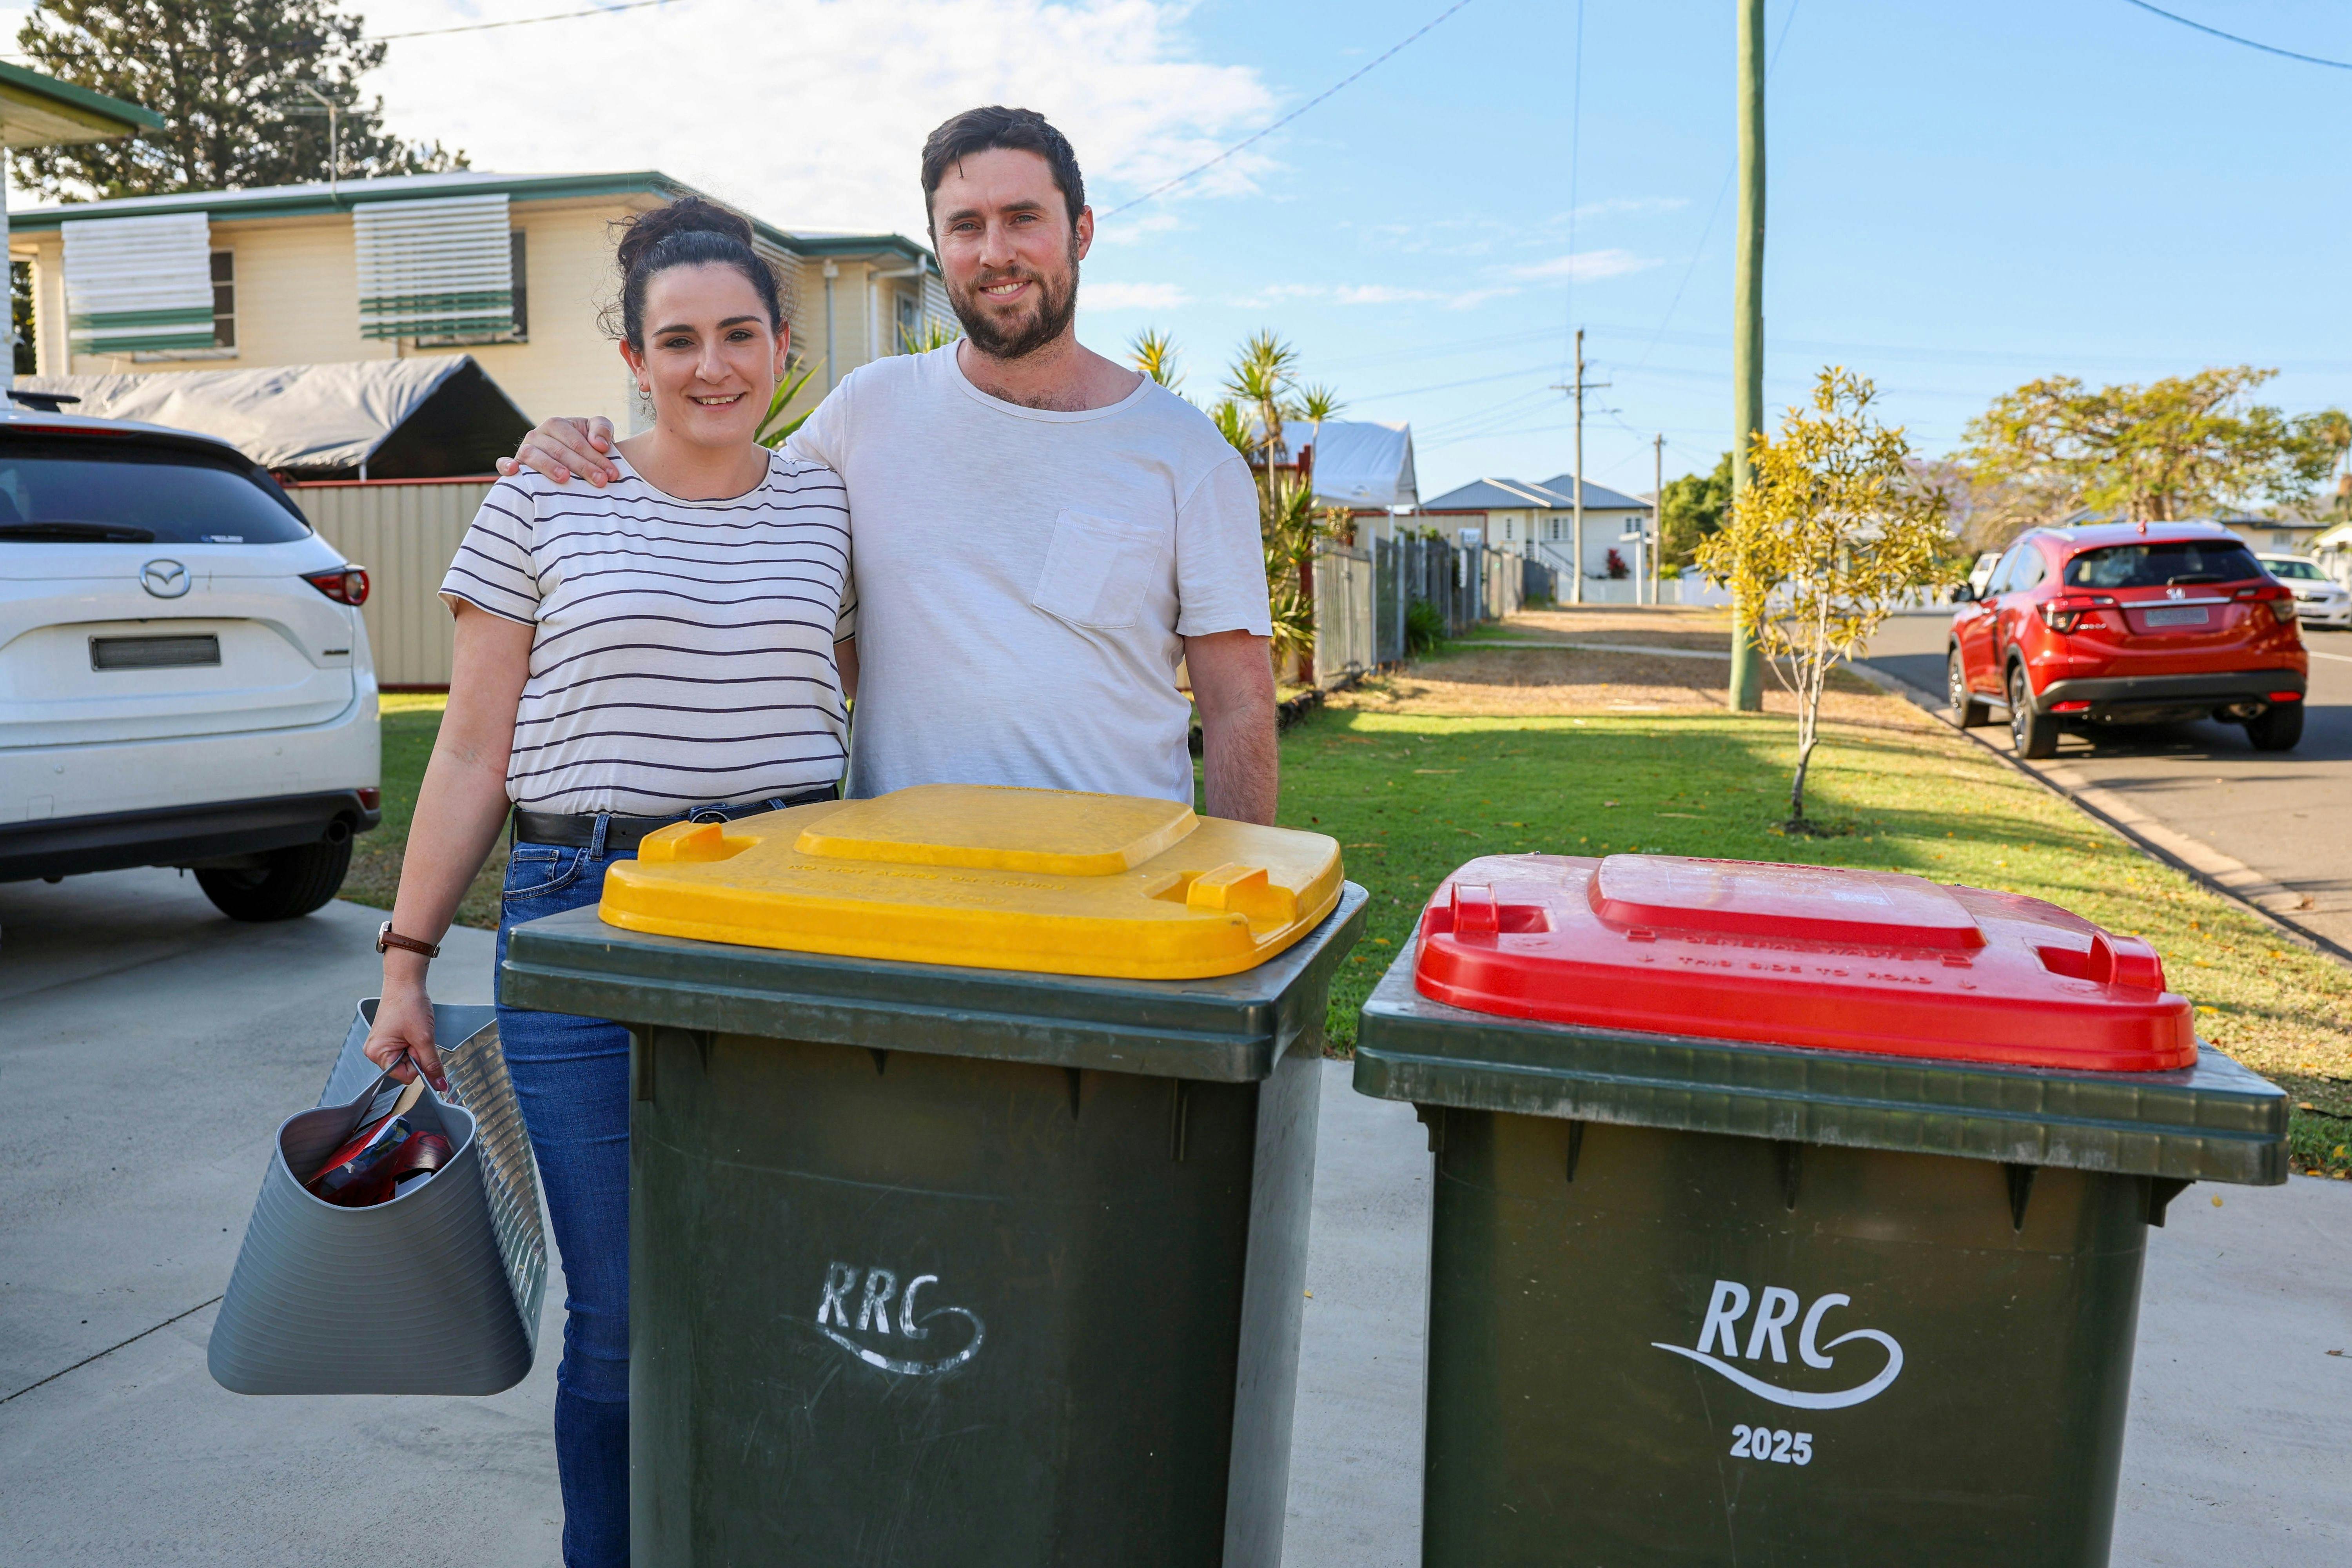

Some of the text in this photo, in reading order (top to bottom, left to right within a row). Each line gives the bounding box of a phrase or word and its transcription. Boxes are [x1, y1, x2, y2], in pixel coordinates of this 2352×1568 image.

[1678, 957, 1933, 984] THIS SIDE TO ROAD
[816, 1261, 938, 1339] RRC
[1696, 1279, 1850, 1369] RRC
[1730, 1424, 1813, 1466] 2025
